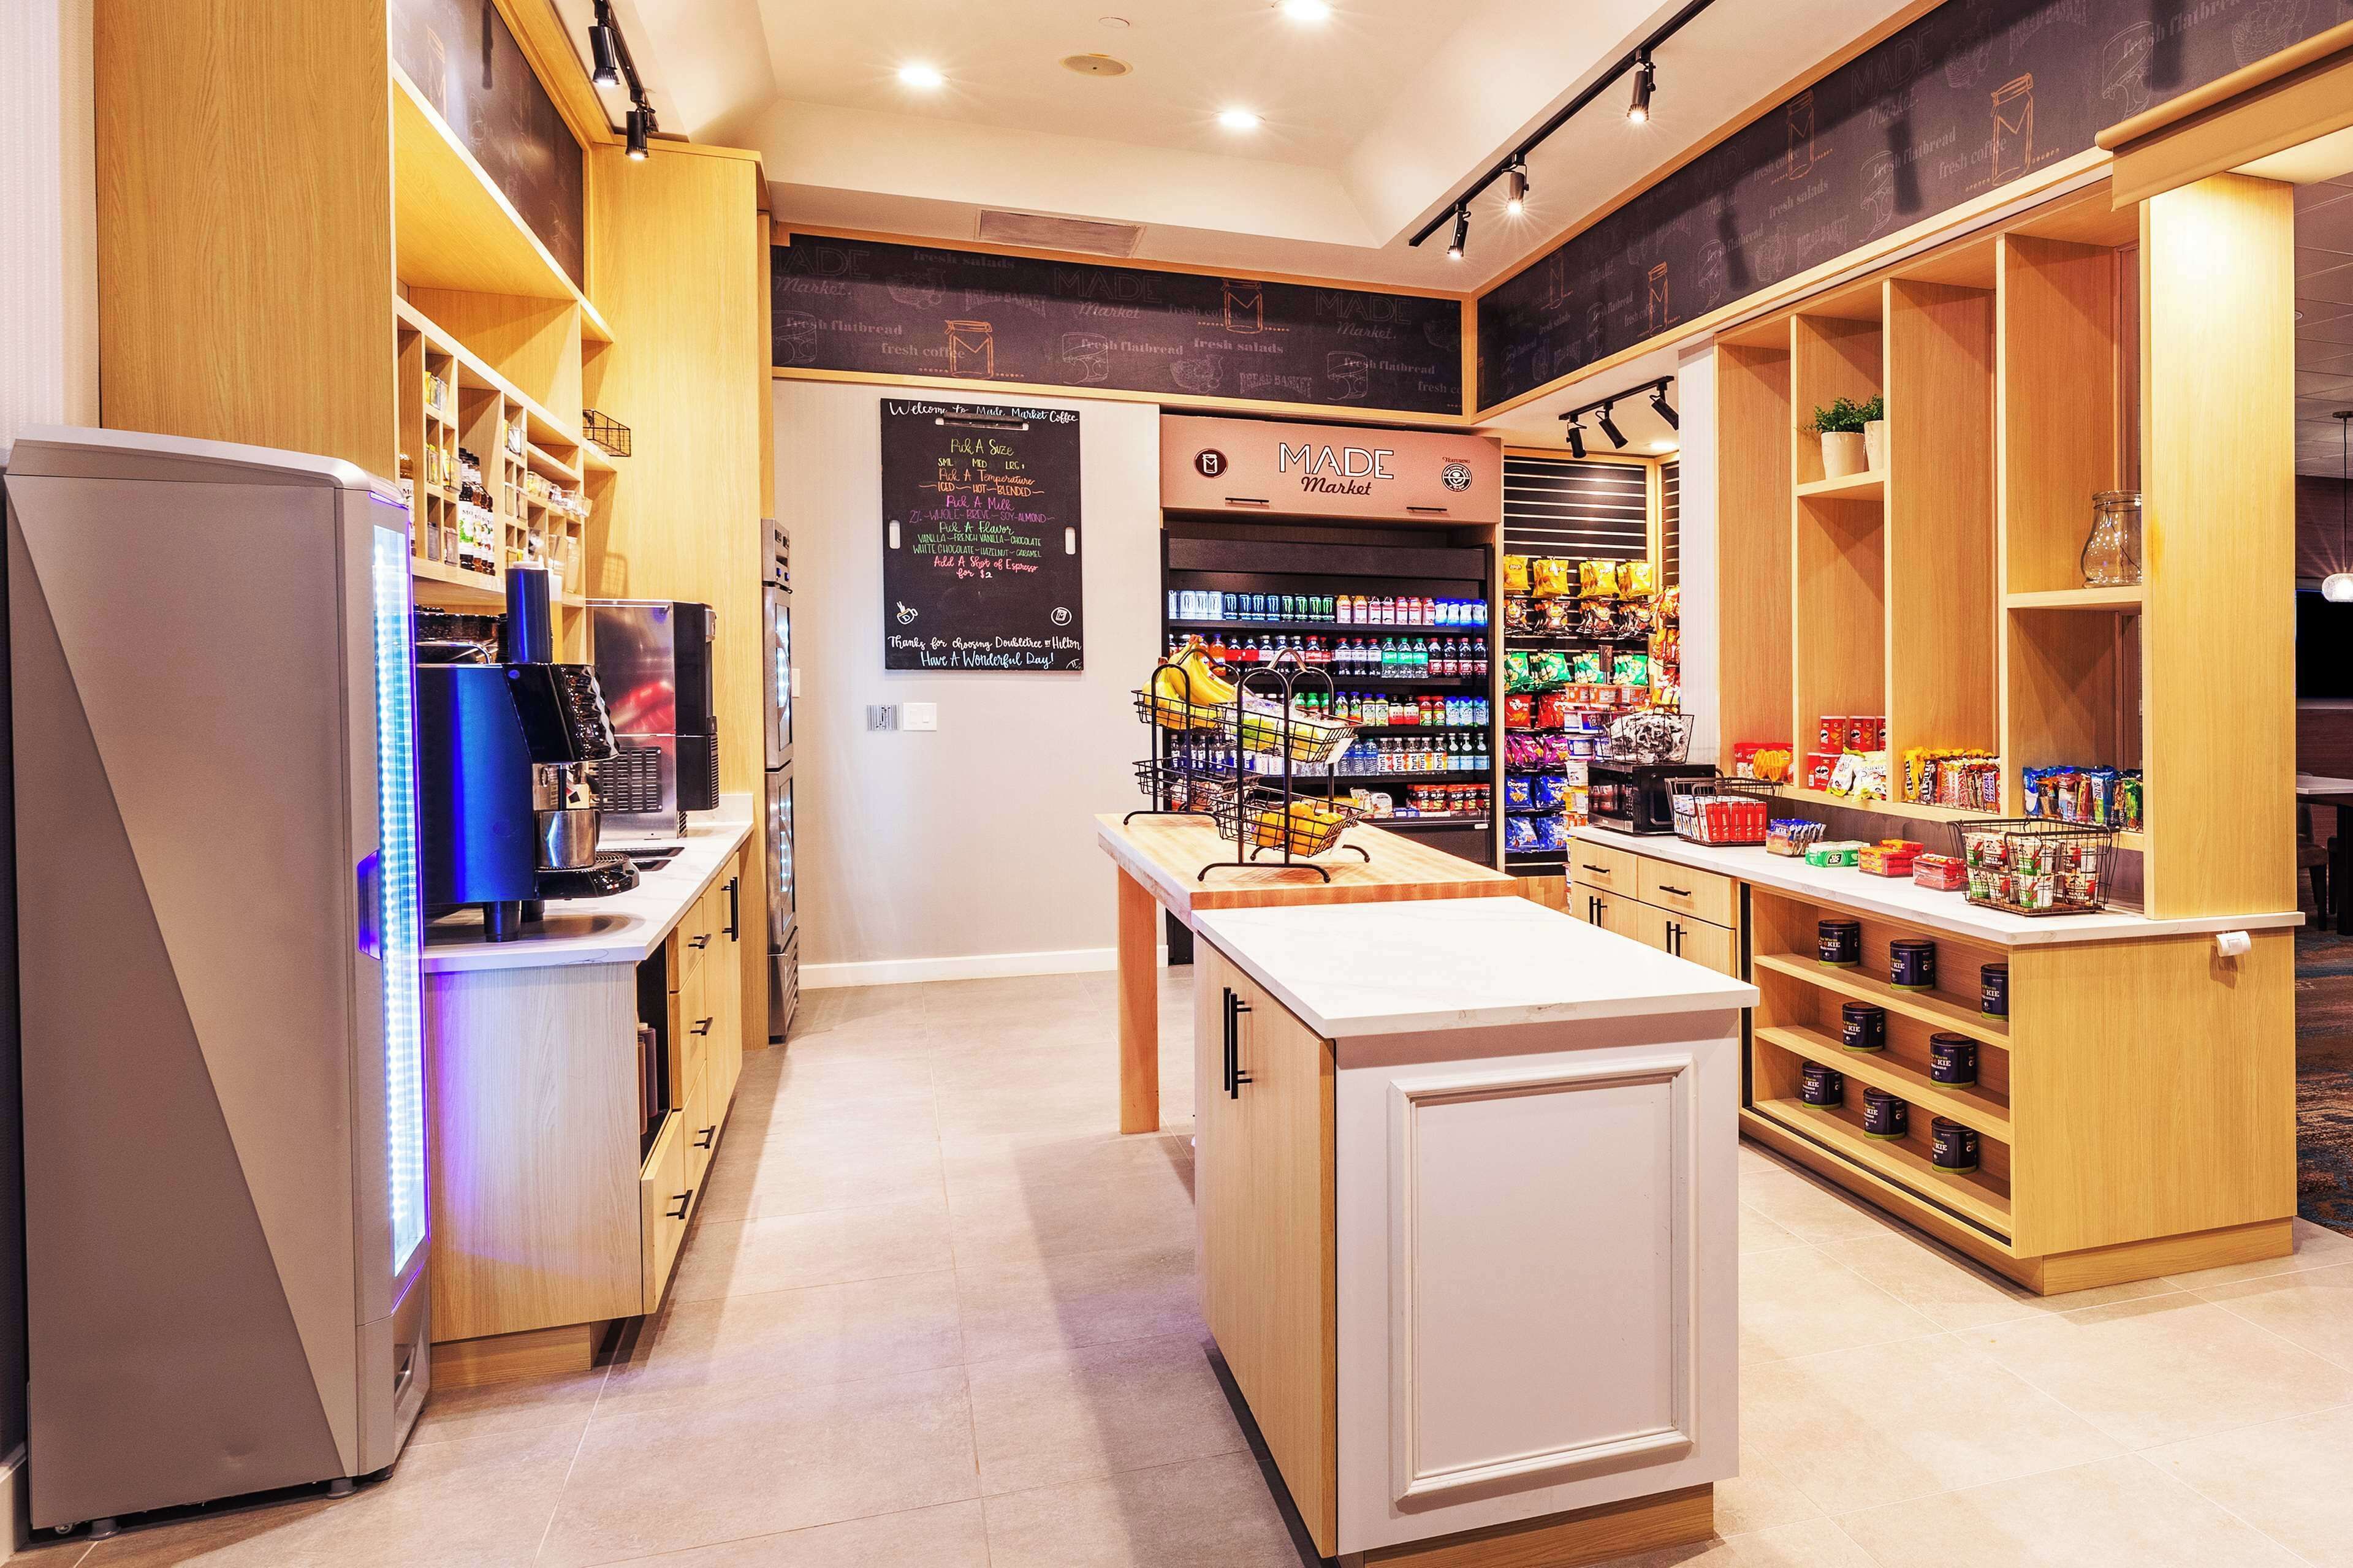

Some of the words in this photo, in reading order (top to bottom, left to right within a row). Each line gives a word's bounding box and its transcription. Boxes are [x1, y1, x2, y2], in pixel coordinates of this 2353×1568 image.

[1938, 153, 1968, 180] fresh
[1770, 195, 1795, 219] fresh
[1796, 178, 1829, 205] salads
[962, 255, 1016, 270] salads
[1054, 267, 1163, 304] MADE
[1167, 303, 1202, 318] fresh
[1315, 289, 1412, 325] MADE
[831, 318, 903, 336] flatbread
[881, 343, 919, 357] fresh
[1119, 340, 1184, 356] flatbread
[1194, 338, 1233, 352] fresh
[1237, 340, 1284, 354] salads
[1378, 359, 1435, 375] flatbread
[1416, 381, 1447, 393] fresh
[889, 401, 948, 416] Welcome
[952, 404, 969, 414] to
[976, 405, 1005, 417] Made
[1011, 407, 1049, 420] Market
[1049, 411, 1079, 424] Coffee
[951, 438, 975, 455] Pick
[975, 438, 985, 454] A
[989, 439, 1014, 456] Size
[938, 458, 954, 467] SML
[972, 458, 988, 469] MED
[1279, 442, 1395, 480] MADE
[938, 468, 960, 482] Pick
[964, 468, 972, 482] A
[978, 469, 1036, 486] Temperature
[937, 482, 956, 492] ICED
[972, 484, 987, 494] HOT
[997, 485, 1032, 498] BLENDED
[1301, 475, 1373, 496] Market
[946, 494, 970, 508] Pick
[973, 496, 983, 508] A
[987, 497, 1015, 512] Milk
[929, 509, 960, 520] WHOLE
[966, 509, 990, 521] BREVE
[939, 521, 961, 534] Pick
[965, 522, 975, 533] A
[978, 521, 1014, 536] Flavor
[918, 534, 946, 543] VANILLA
[953, 534, 978, 543] FRENCH
[980, 534, 1005, 544] VANILLA
[1010, 536, 1041, 547] CHOCOLATE
[913, 543, 937, 555] WHITE
[938, 545, 975, 556] CHOCOLATE
[1016, 548, 1042, 558] CARAMEL
[933, 556, 954, 567] Add
[957, 556, 966, 567] A
[970, 556, 990, 570] Shot
[993, 558, 1003, 570] of
[1006, 558, 1038, 574] Espresso
[956, 568, 975, 579] for
[980, 570, 993, 579] $2
[888, 635, 926, 651] Thanks
[932, 636, 948, 650] for
[952, 636, 992, 652] choosing
[1052, 636, 1082, 651] Hilton
[921, 651, 948, 667] Have
[951, 651, 960, 667] A
[962, 651, 1023, 669] Wonderful
[1026, 652, 1054, 670] Day!
